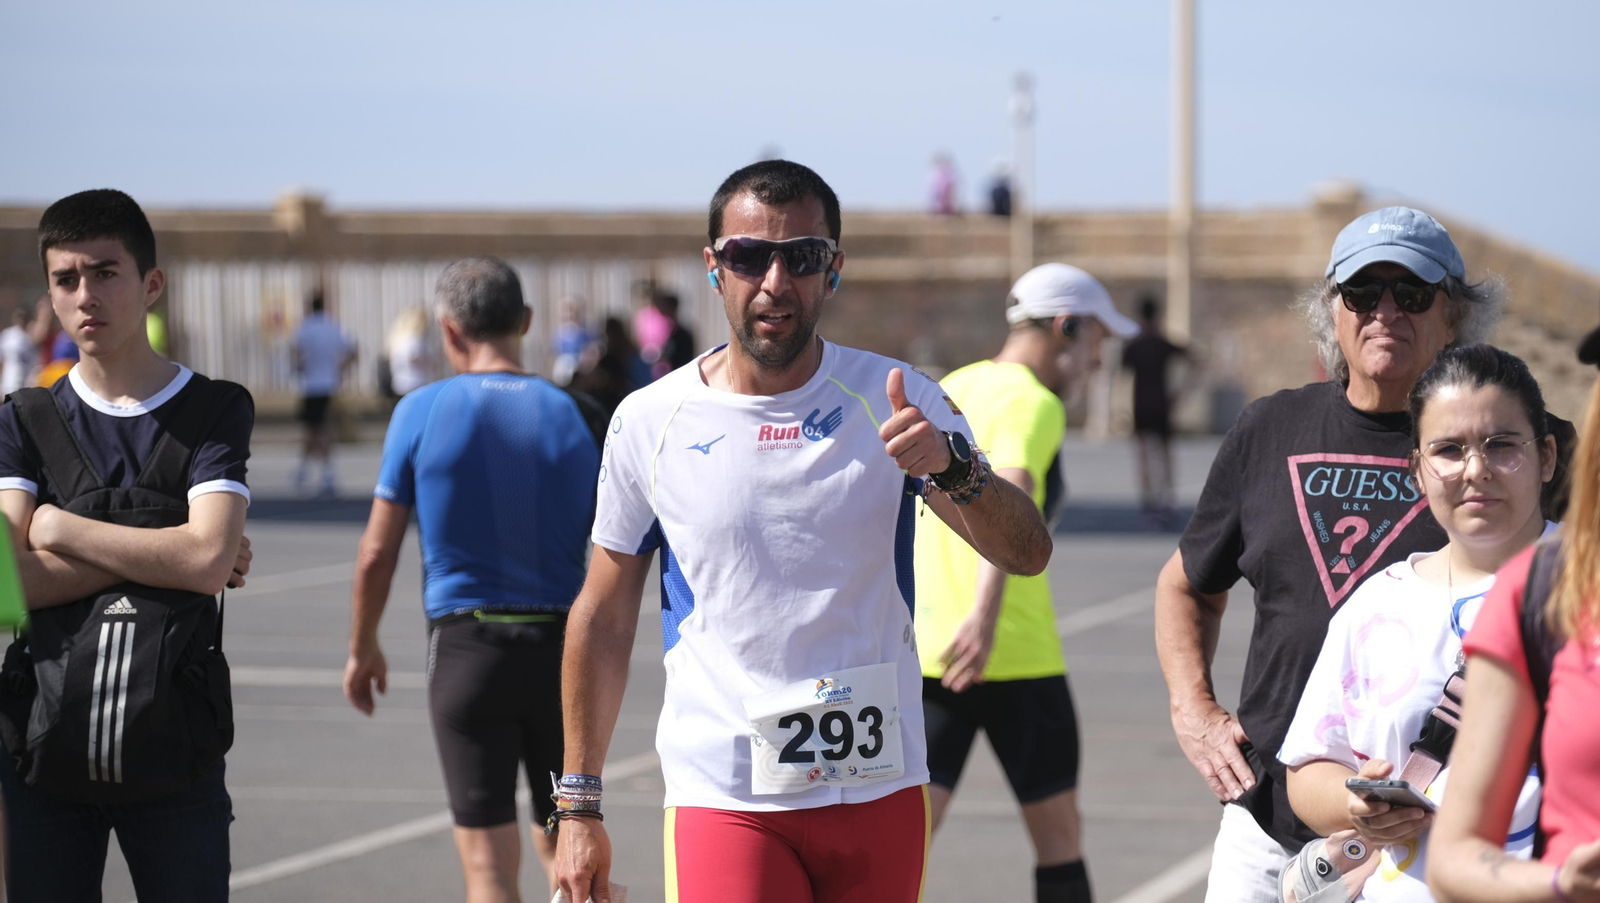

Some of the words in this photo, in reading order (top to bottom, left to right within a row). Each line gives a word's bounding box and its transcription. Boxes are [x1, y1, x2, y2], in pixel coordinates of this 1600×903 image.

[757, 424, 800, 441] Run
[804, 426, 825, 439] 04
[757, 441, 803, 452] atletismo
[1304, 466, 1420, 502] GUESS
[1312, 510, 1330, 544] WASHED
[1369, 518, 1392, 543] JEANS
[778, 706, 883, 764] 293
